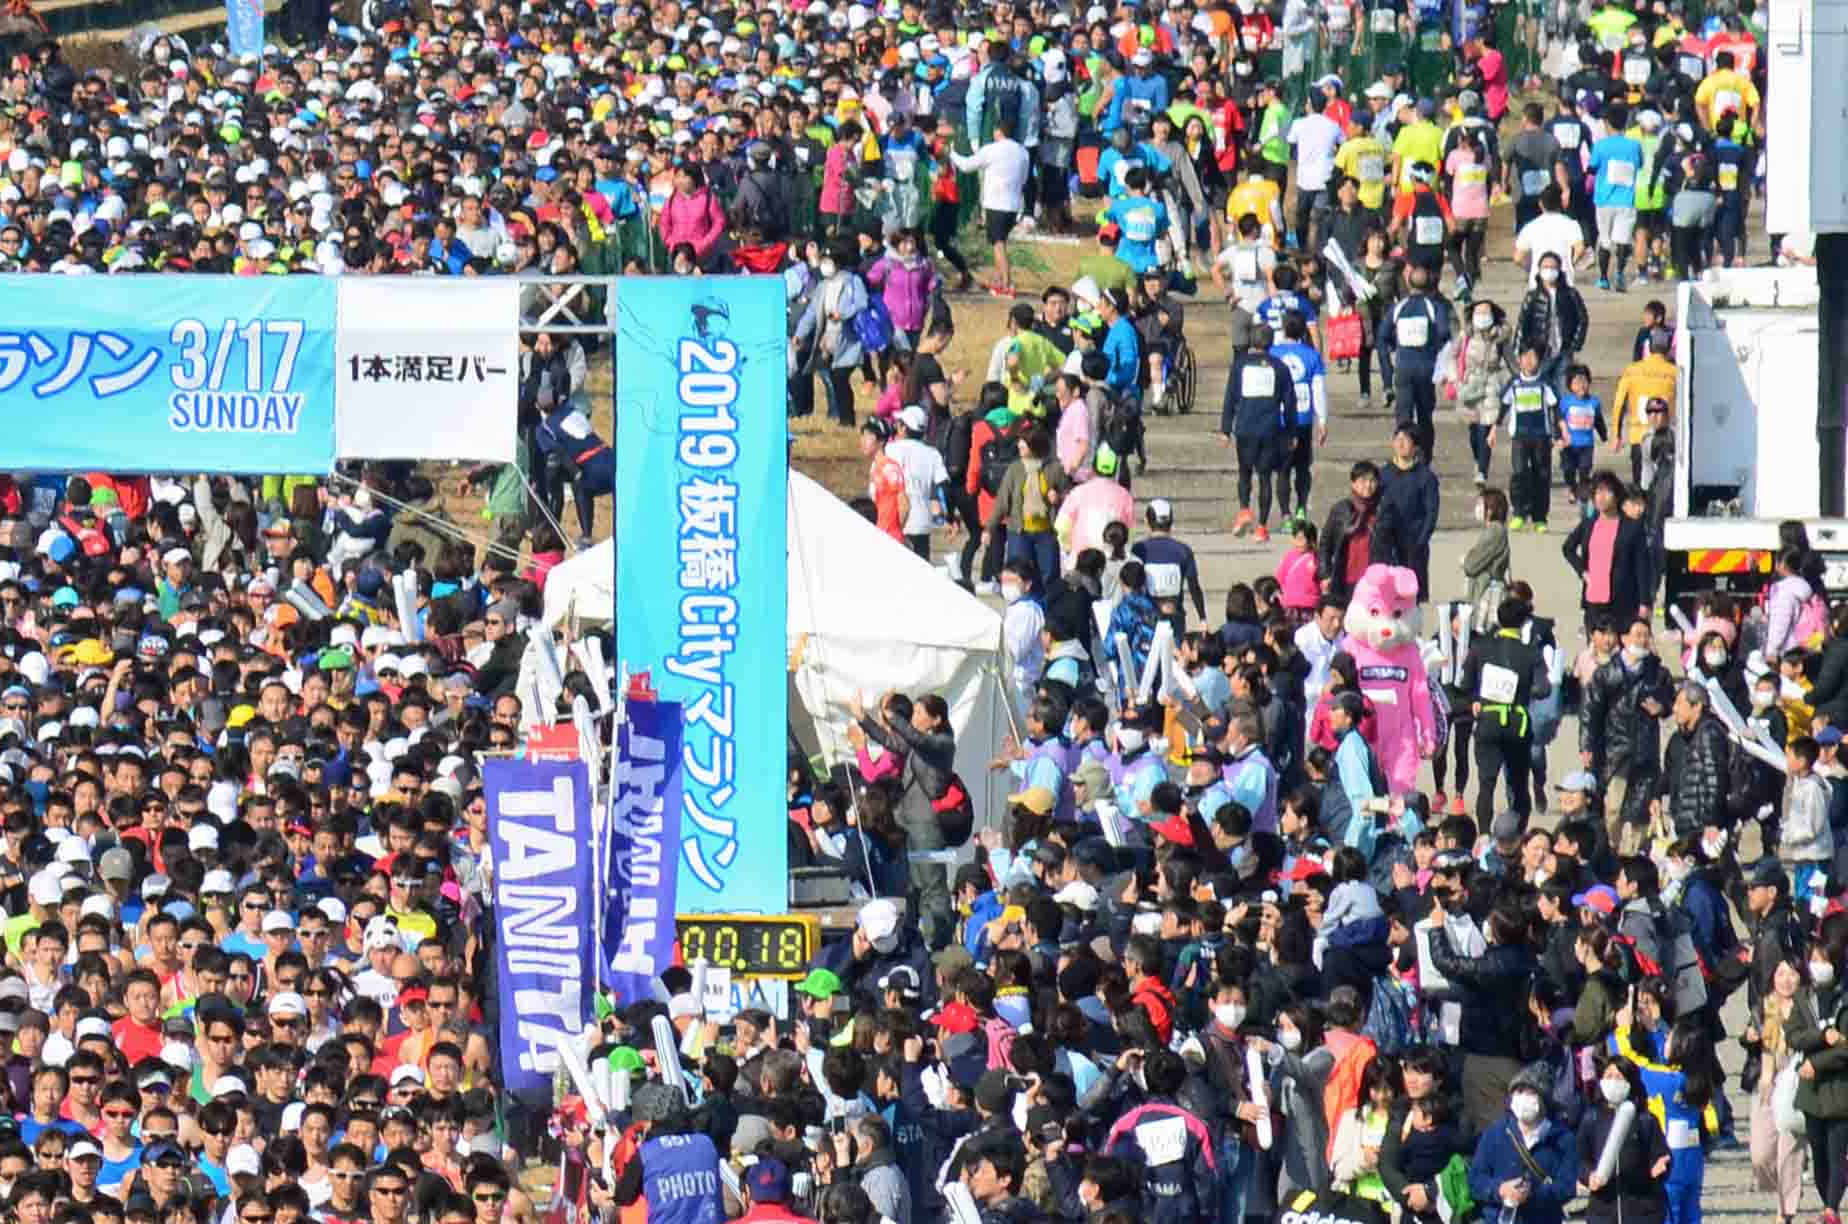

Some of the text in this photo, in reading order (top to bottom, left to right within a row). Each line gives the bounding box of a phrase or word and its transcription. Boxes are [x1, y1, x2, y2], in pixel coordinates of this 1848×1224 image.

[168, 318, 305, 394] 3/17
[349, 352, 508, 386] 1本満足バー
[170, 392, 304, 433] SUNDAY
[677, 340, 739, 468] 2019
[498, 775, 583, 1073] TANITA
[656, 1170, 716, 1203] PHOTO
